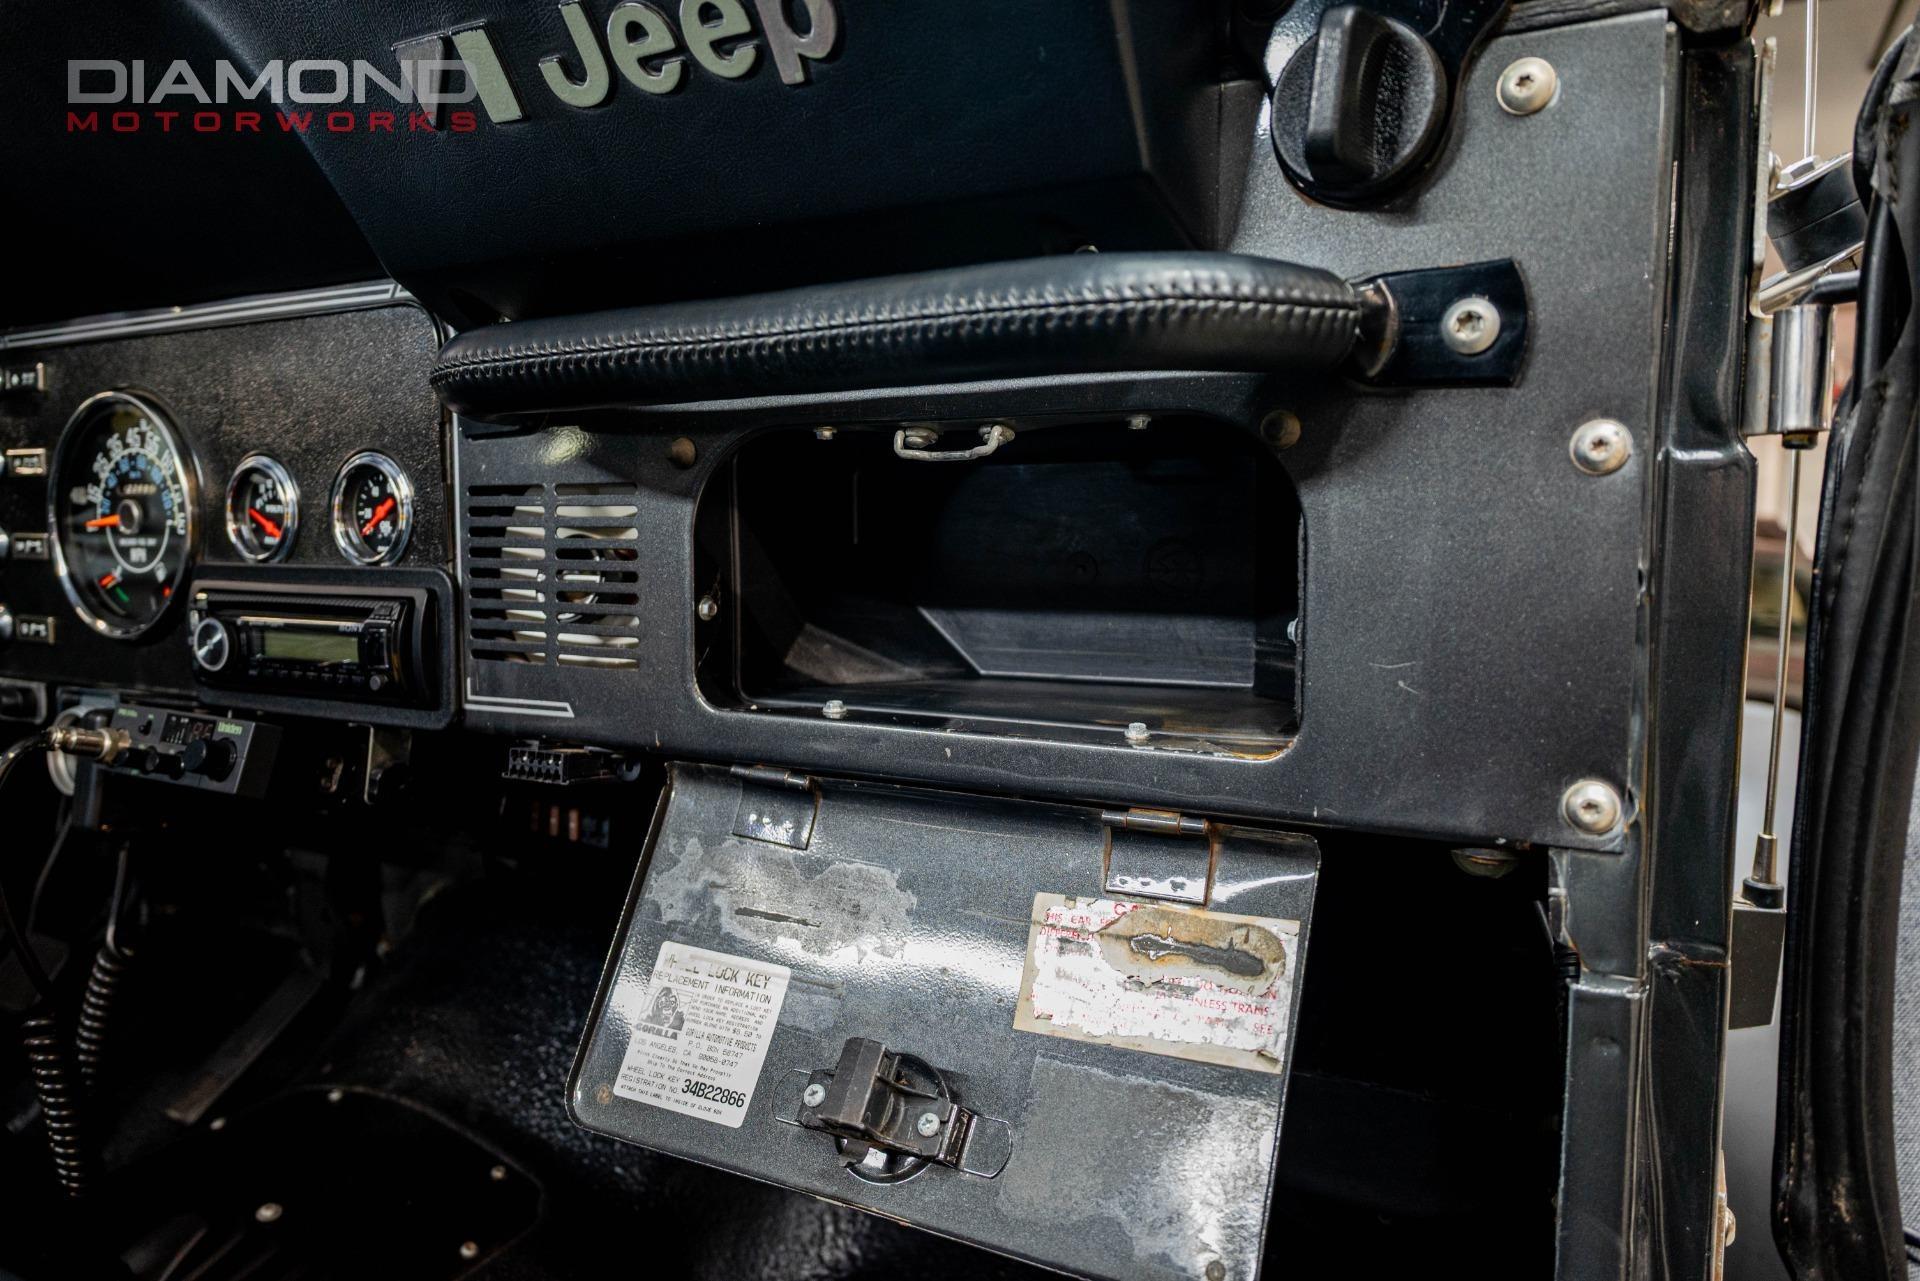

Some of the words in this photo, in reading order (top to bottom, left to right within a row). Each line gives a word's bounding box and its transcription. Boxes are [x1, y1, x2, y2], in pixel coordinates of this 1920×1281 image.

[538, 0, 838, 108] Jeep
[218, 722, 243, 735] Uniden
[652, 970, 709, 990] REPLACEMENT
[713, 983, 772, 1004] INFORMATION
[745, 971, 771, 989] KEY
[634, 1022, 679, 1040] GORILLA
[633, 1037, 647, 1046] LOS
[705, 1032, 734, 1046] AUTOMOTIVE
[733, 1039, 757, 1052] PRODUCTS
[706, 1044, 720, 1053] BOX
[620, 1073, 666, 1090] REGISTRATION
[626, 1064, 646, 1074] WHEEL
[648, 1070, 665, 1079] LOCK
[667, 1074, 680, 1083] KEY
[681, 1078, 747, 1108] 34B22866
